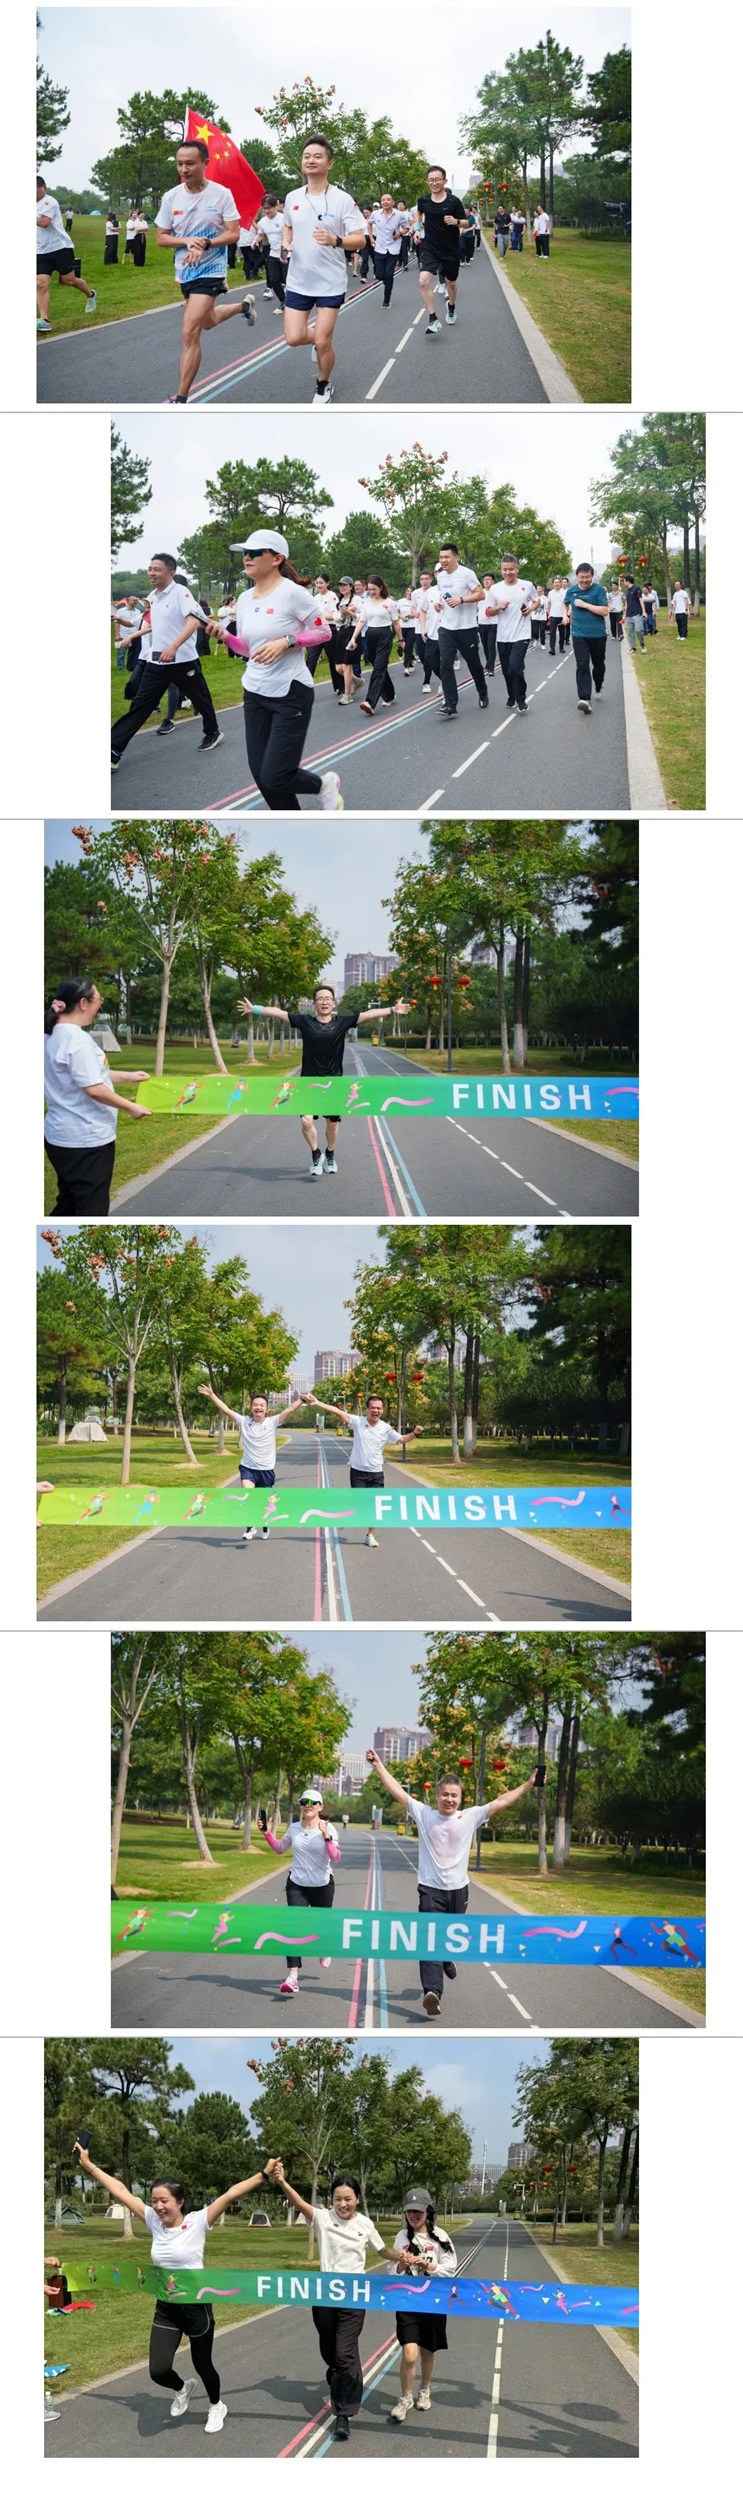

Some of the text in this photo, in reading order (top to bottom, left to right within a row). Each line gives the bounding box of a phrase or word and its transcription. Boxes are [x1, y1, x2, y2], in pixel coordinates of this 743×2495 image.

[452, 1083, 592, 1110] FINISH
[374, 1495, 518, 1521] FINISH
[342, 1918, 505, 1954] FINISH
[257, 2276, 371, 2302] FINISH
